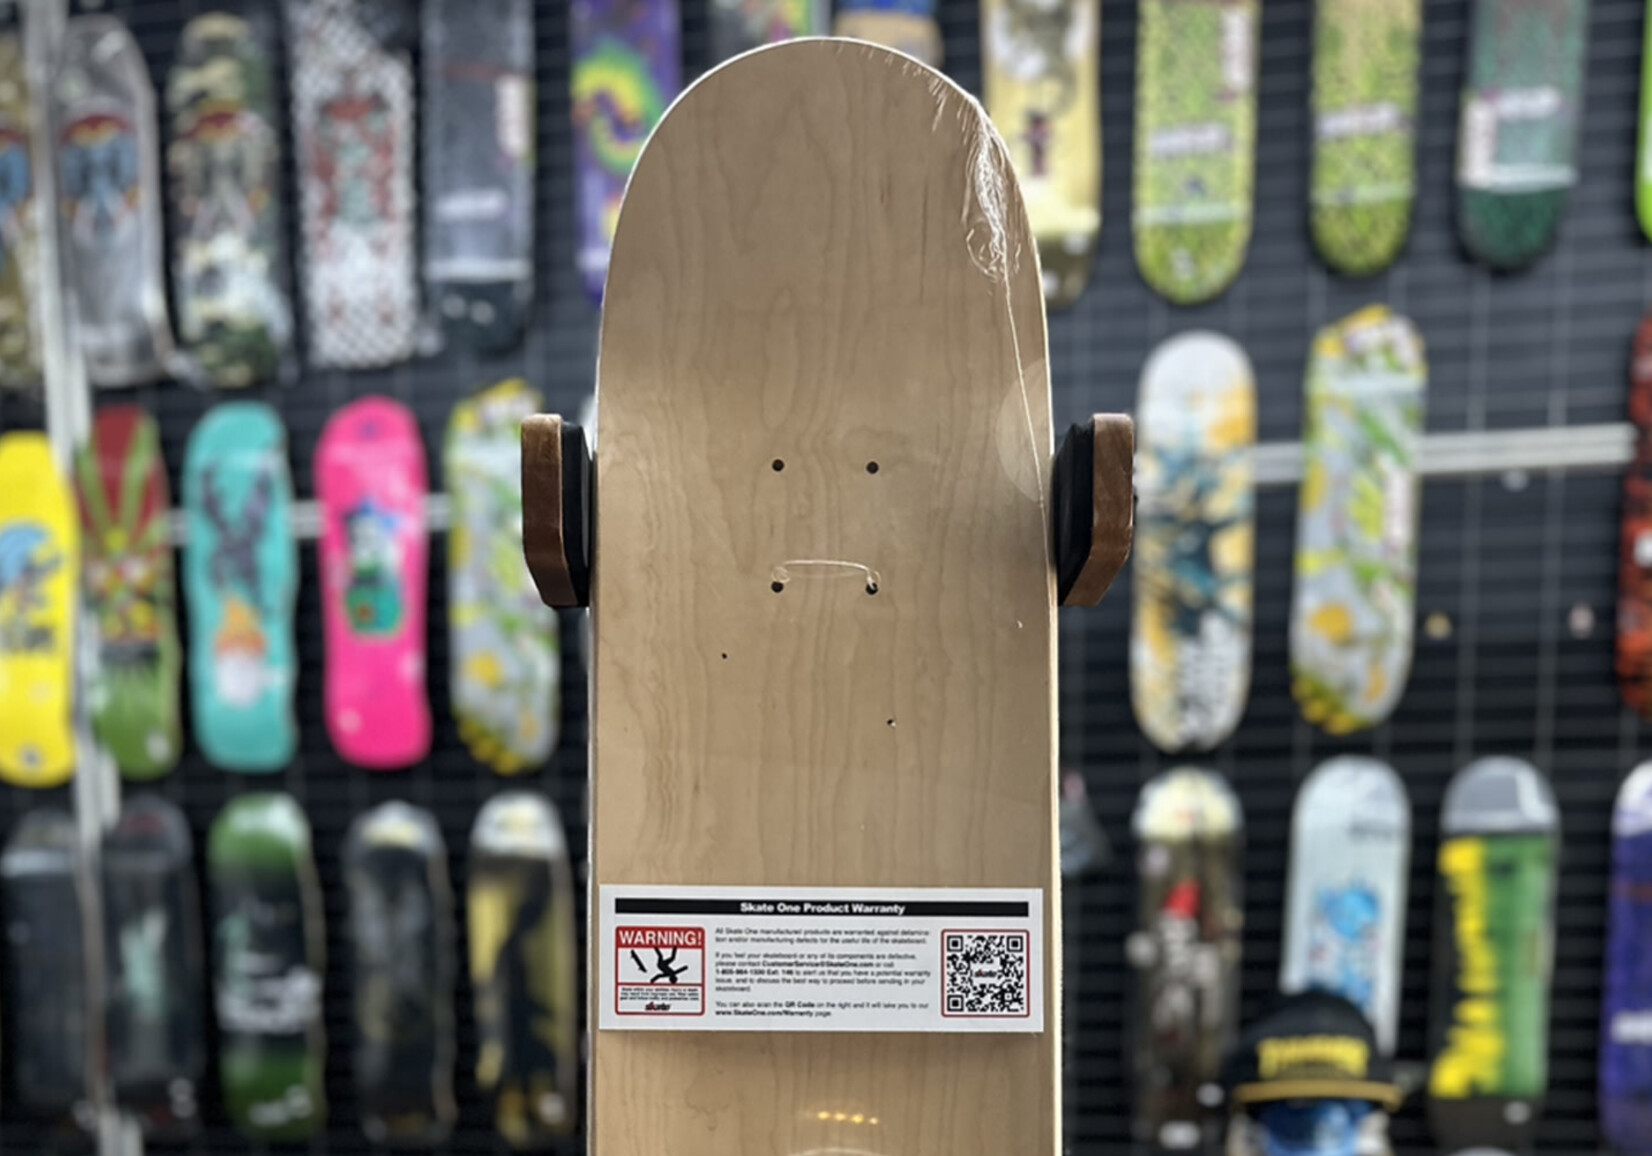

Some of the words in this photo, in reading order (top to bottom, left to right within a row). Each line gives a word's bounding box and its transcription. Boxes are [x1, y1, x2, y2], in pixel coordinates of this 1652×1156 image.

[740, 902, 774, 912] Skate
[776, 902, 801, 912] One
[803, 902, 849, 913] Product
[851, 903, 906, 915] Warranty
[618, 930, 702, 946] WARNING!
